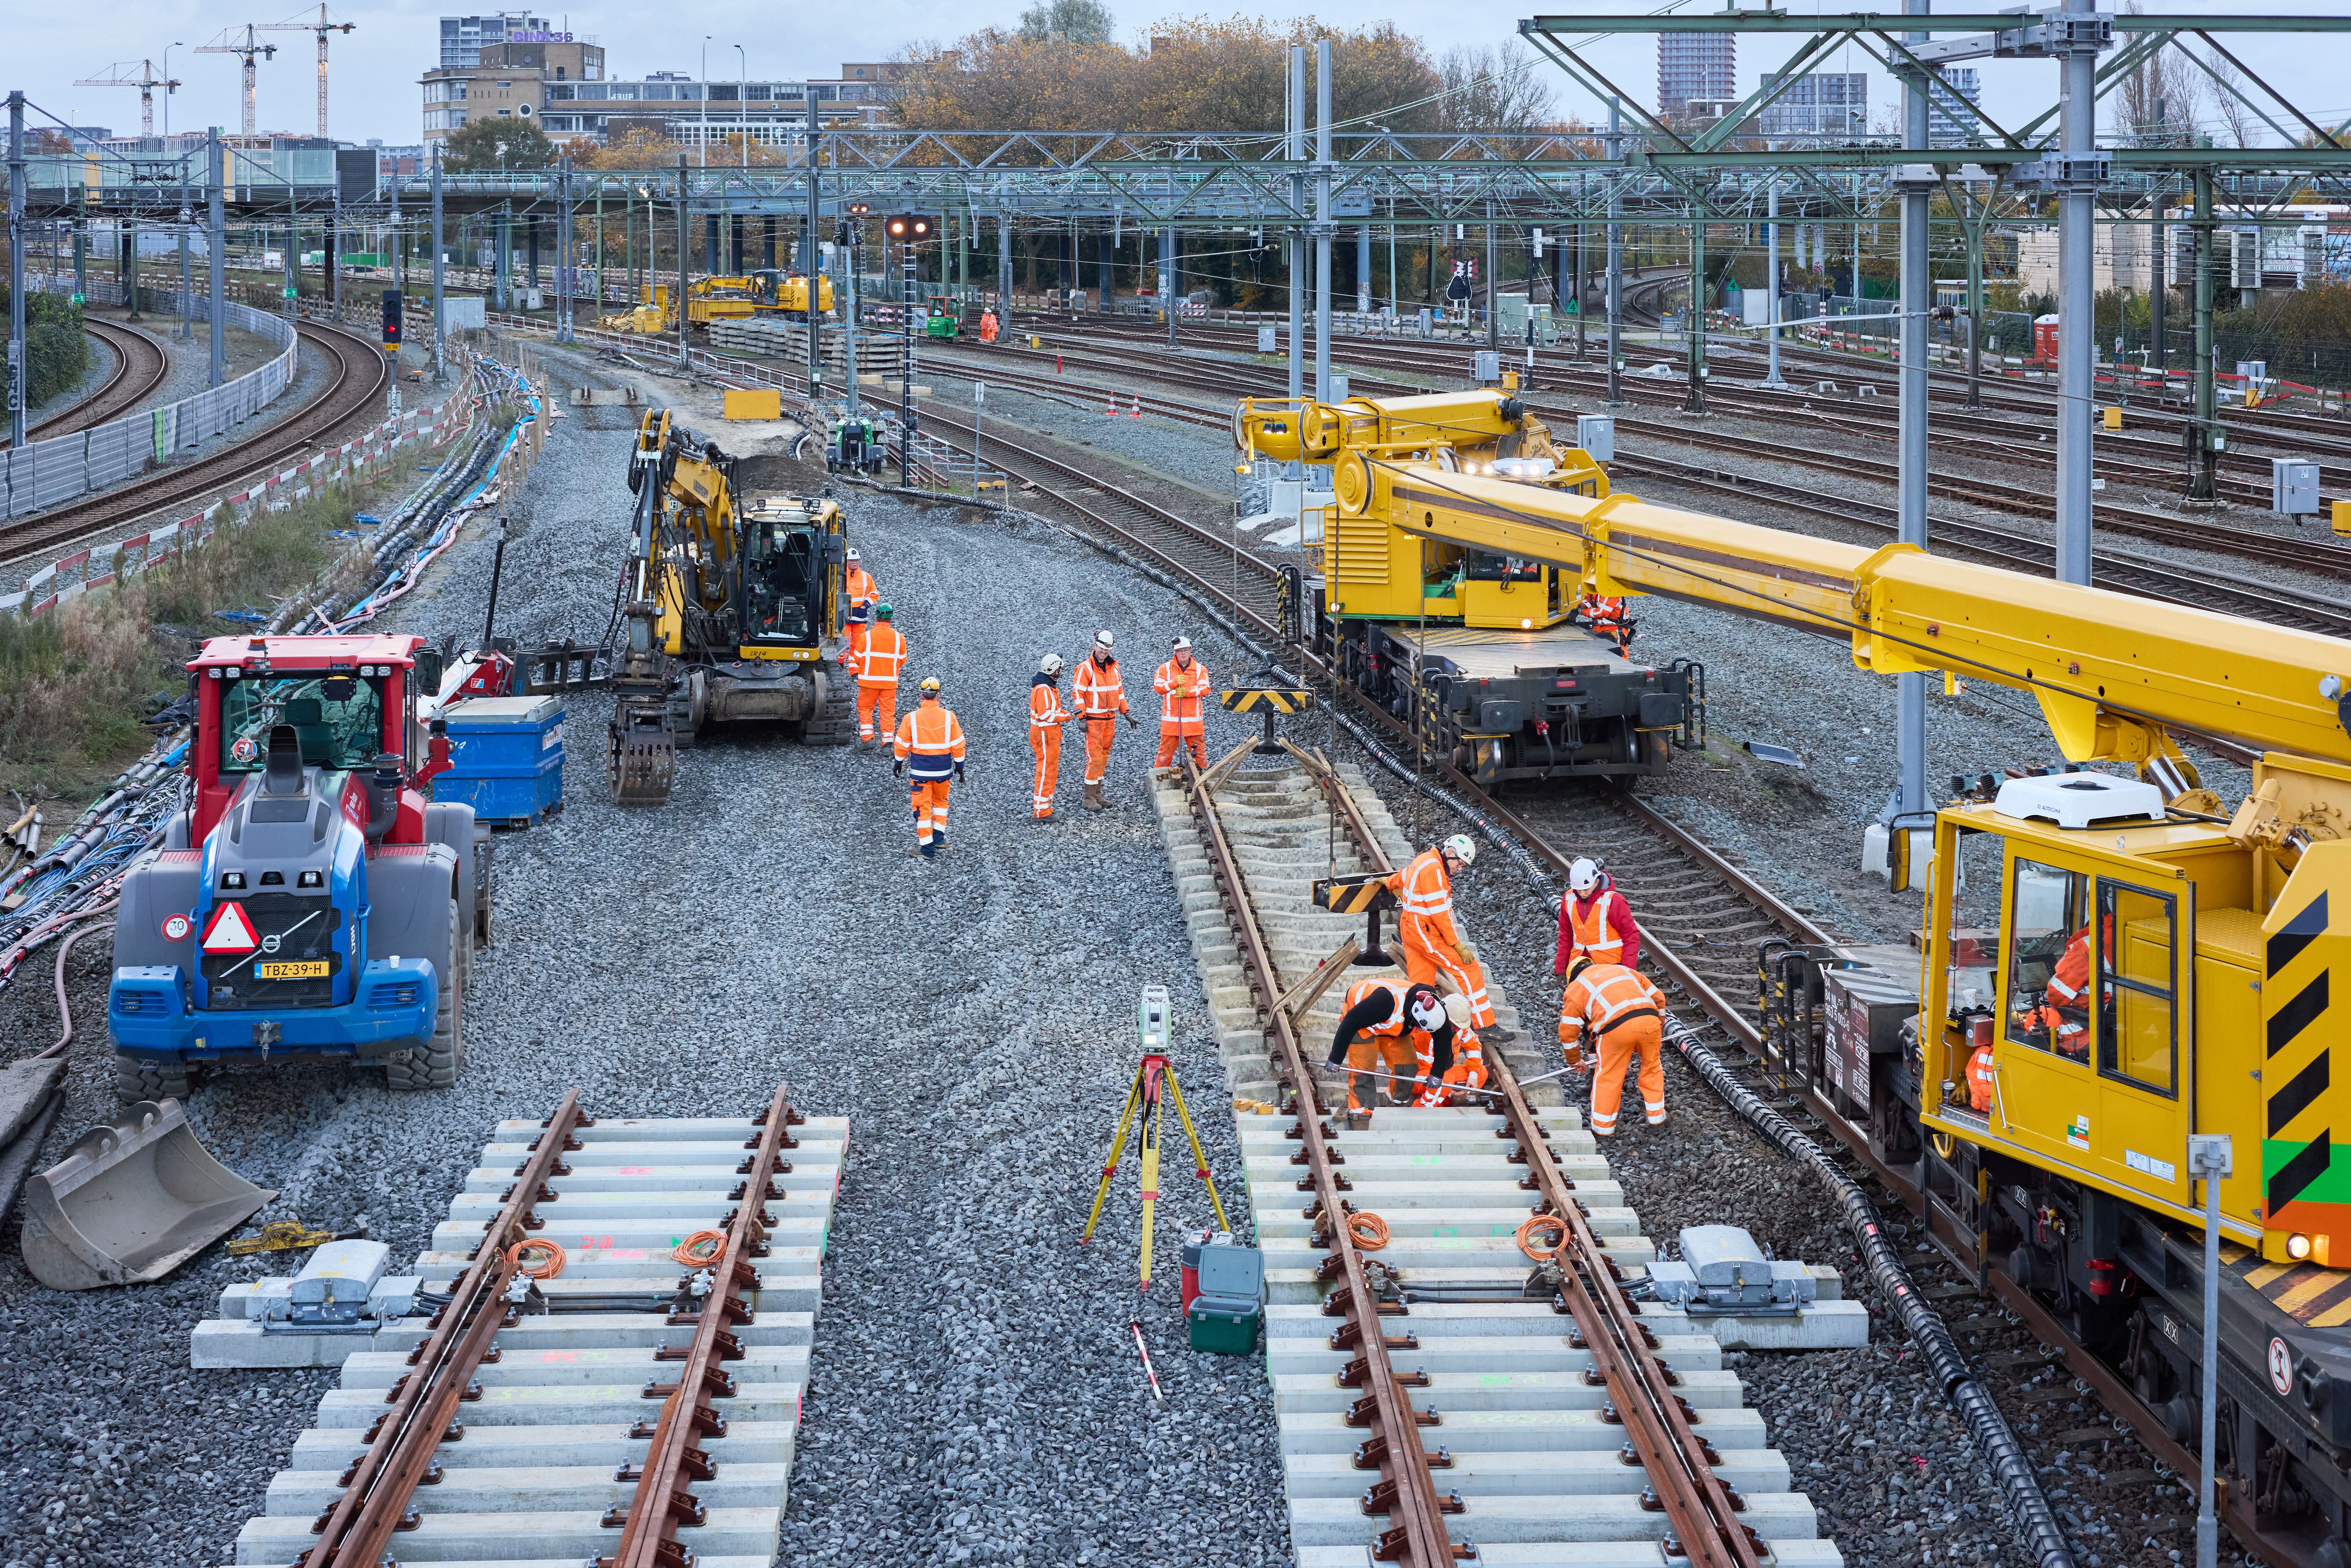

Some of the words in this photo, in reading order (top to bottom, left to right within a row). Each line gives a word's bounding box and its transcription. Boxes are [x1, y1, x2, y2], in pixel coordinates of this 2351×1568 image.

[514, 32, 551, 42] BINK
[554, 32, 573, 42] 36
[2042, 806, 2060, 814] AUTOCLIMA
[170, 921, 184, 931] 30
[264, 964, 321, 976] TBZ-39-H
[1825, 975, 1830, 988] 84
[1825, 989, 1830, 1002] 84
[1853, 999, 1858, 1010] 94
[1825, 1003, 1833, 1018] 963
[1834, 1010, 1837, 1021] 5
[1838, 1012, 1850, 1032] 003-6
[1832, 1052, 1837, 1065] KM
[1854, 1074, 1858, 1085] R
[1858, 1077, 1864, 1089] 90
[1864, 1084, 1868, 1094] m
